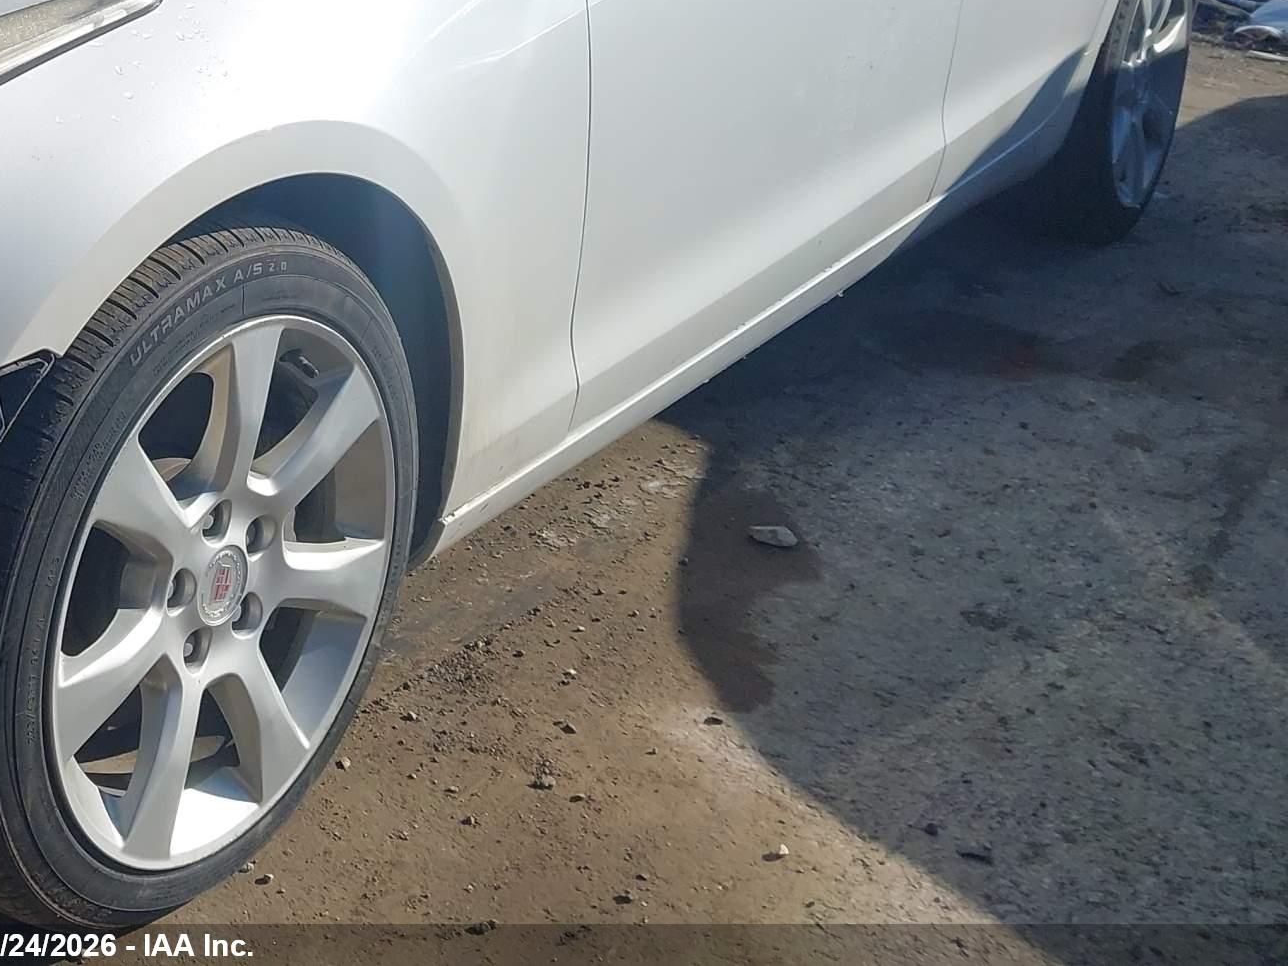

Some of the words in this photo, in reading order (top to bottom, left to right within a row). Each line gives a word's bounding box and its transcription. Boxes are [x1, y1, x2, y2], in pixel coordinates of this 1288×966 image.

[130, 277, 226, 367] ULTRAMAX
[233, 262, 263, 284] A/S
[268, 261, 287, 273] 2.0
